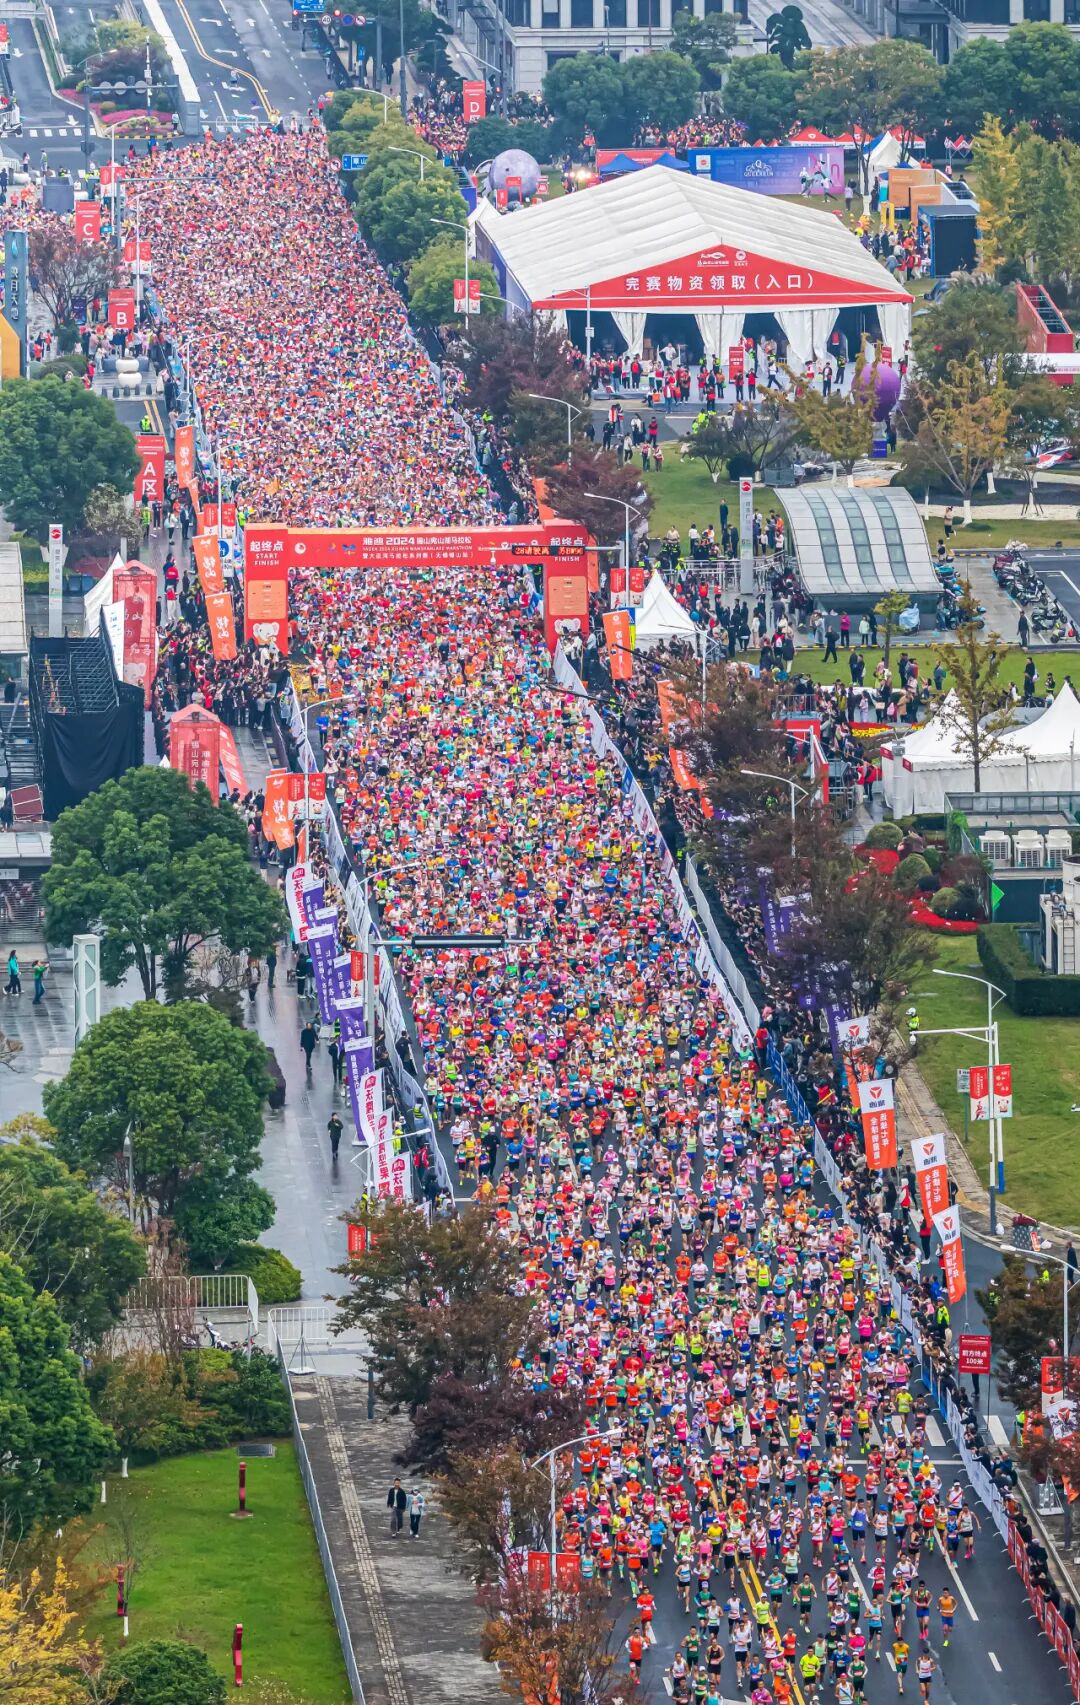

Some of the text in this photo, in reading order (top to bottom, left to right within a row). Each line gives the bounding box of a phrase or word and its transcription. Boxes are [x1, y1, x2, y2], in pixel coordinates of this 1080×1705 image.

[470, 101, 480, 113] D
[83, 223, 93, 235] C
[626, 273, 813, 292] 完赛物资领取（入口）
[116, 311, 128, 325] B
[143, 462, 156, 476] A
[142, 479, 157, 496] 区
[249, 540, 284, 552] 起终点
[386, 537, 415, 545] 2024
